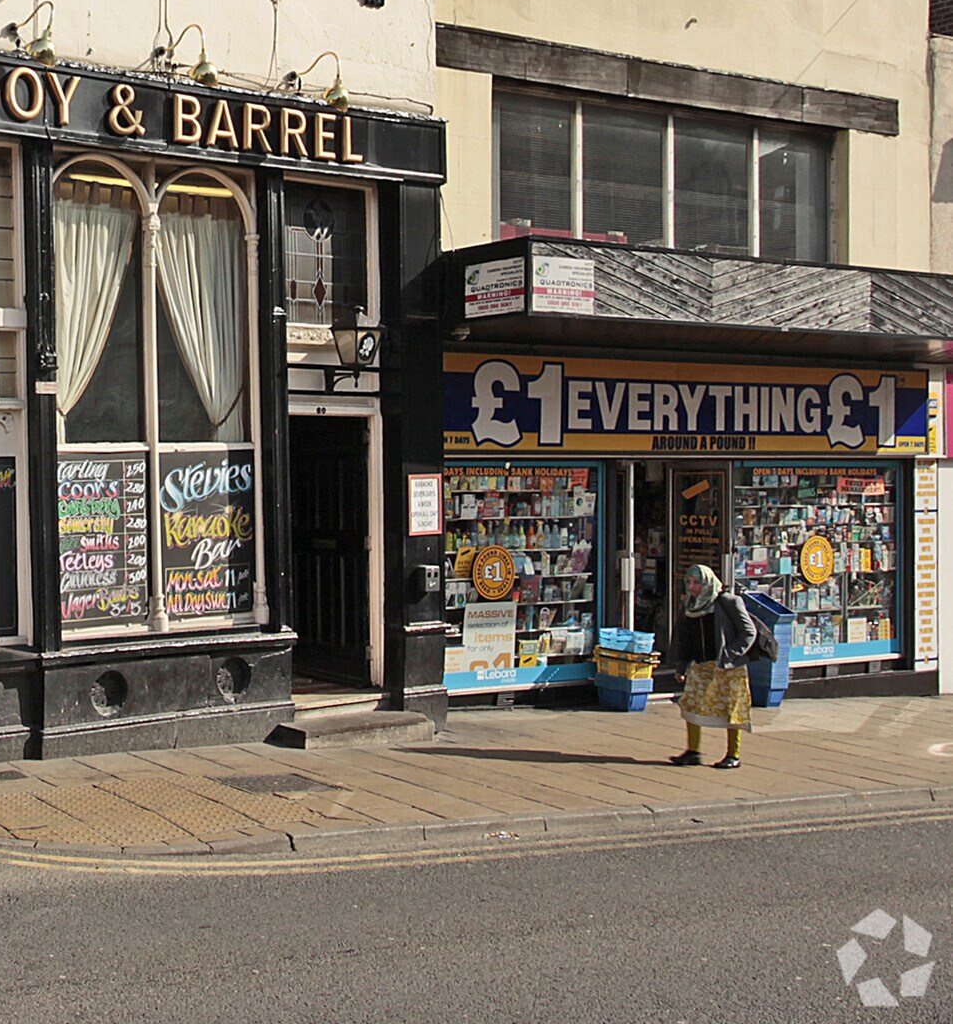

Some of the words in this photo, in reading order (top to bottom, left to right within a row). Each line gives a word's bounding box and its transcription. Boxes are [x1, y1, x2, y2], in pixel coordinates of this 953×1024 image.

[108, 84, 147, 137] &
[174, 93, 364, 164] BARREL
[470, 280, 523, 293] QUADTRONICS
[540, 279, 593, 289] QUADTRONICS
[547, 288, 583, 296] WARNING!
[476, 289, 512, 300] WARNING!
[471, 360, 563, 447] £1
[568, 380, 822, 433] EVERYTHING
[827, 373, 895, 448] £1
[652, 436, 698, 450] AROUND
[700, 436, 708, 450] A
[710, 436, 746, 450] POUND
[748, 436, 756, 450] !!
[57, 460, 110, 484] Carling
[444, 468, 464, 476] DAYS
[466, 468, 509, 476] INCLUDING
[511, 468, 532, 476] BANK
[534, 468, 572, 476] HOLIDAYS
[795, 468, 828, 476] INCLUDING
[830, 468, 846, 476] BANK
[848, 468, 877, 476] HOLIDAYS
[58, 480, 120, 500] Coors
[160, 459, 252, 513] Stevies
[58, 497, 121, 520] Carlsberg
[164, 507, 253, 548] Karaoke
[679, 514, 718, 526] CCTV
[679, 536, 719, 544] OPERATION
[59, 550, 114, 574] Tetleys
[191, 538, 242, 570] Bar
[809, 550, 824, 568] £1
[225, 568, 236, 588] 11
[485, 561, 503, 582] £1
[60, 569, 117, 594] Guinness
[468, 610, 514, 618] MASSIVE
[474, 632, 512, 642] items
[809, 646, 834, 654] Lebara
[484, 669, 517, 679] Lebara
